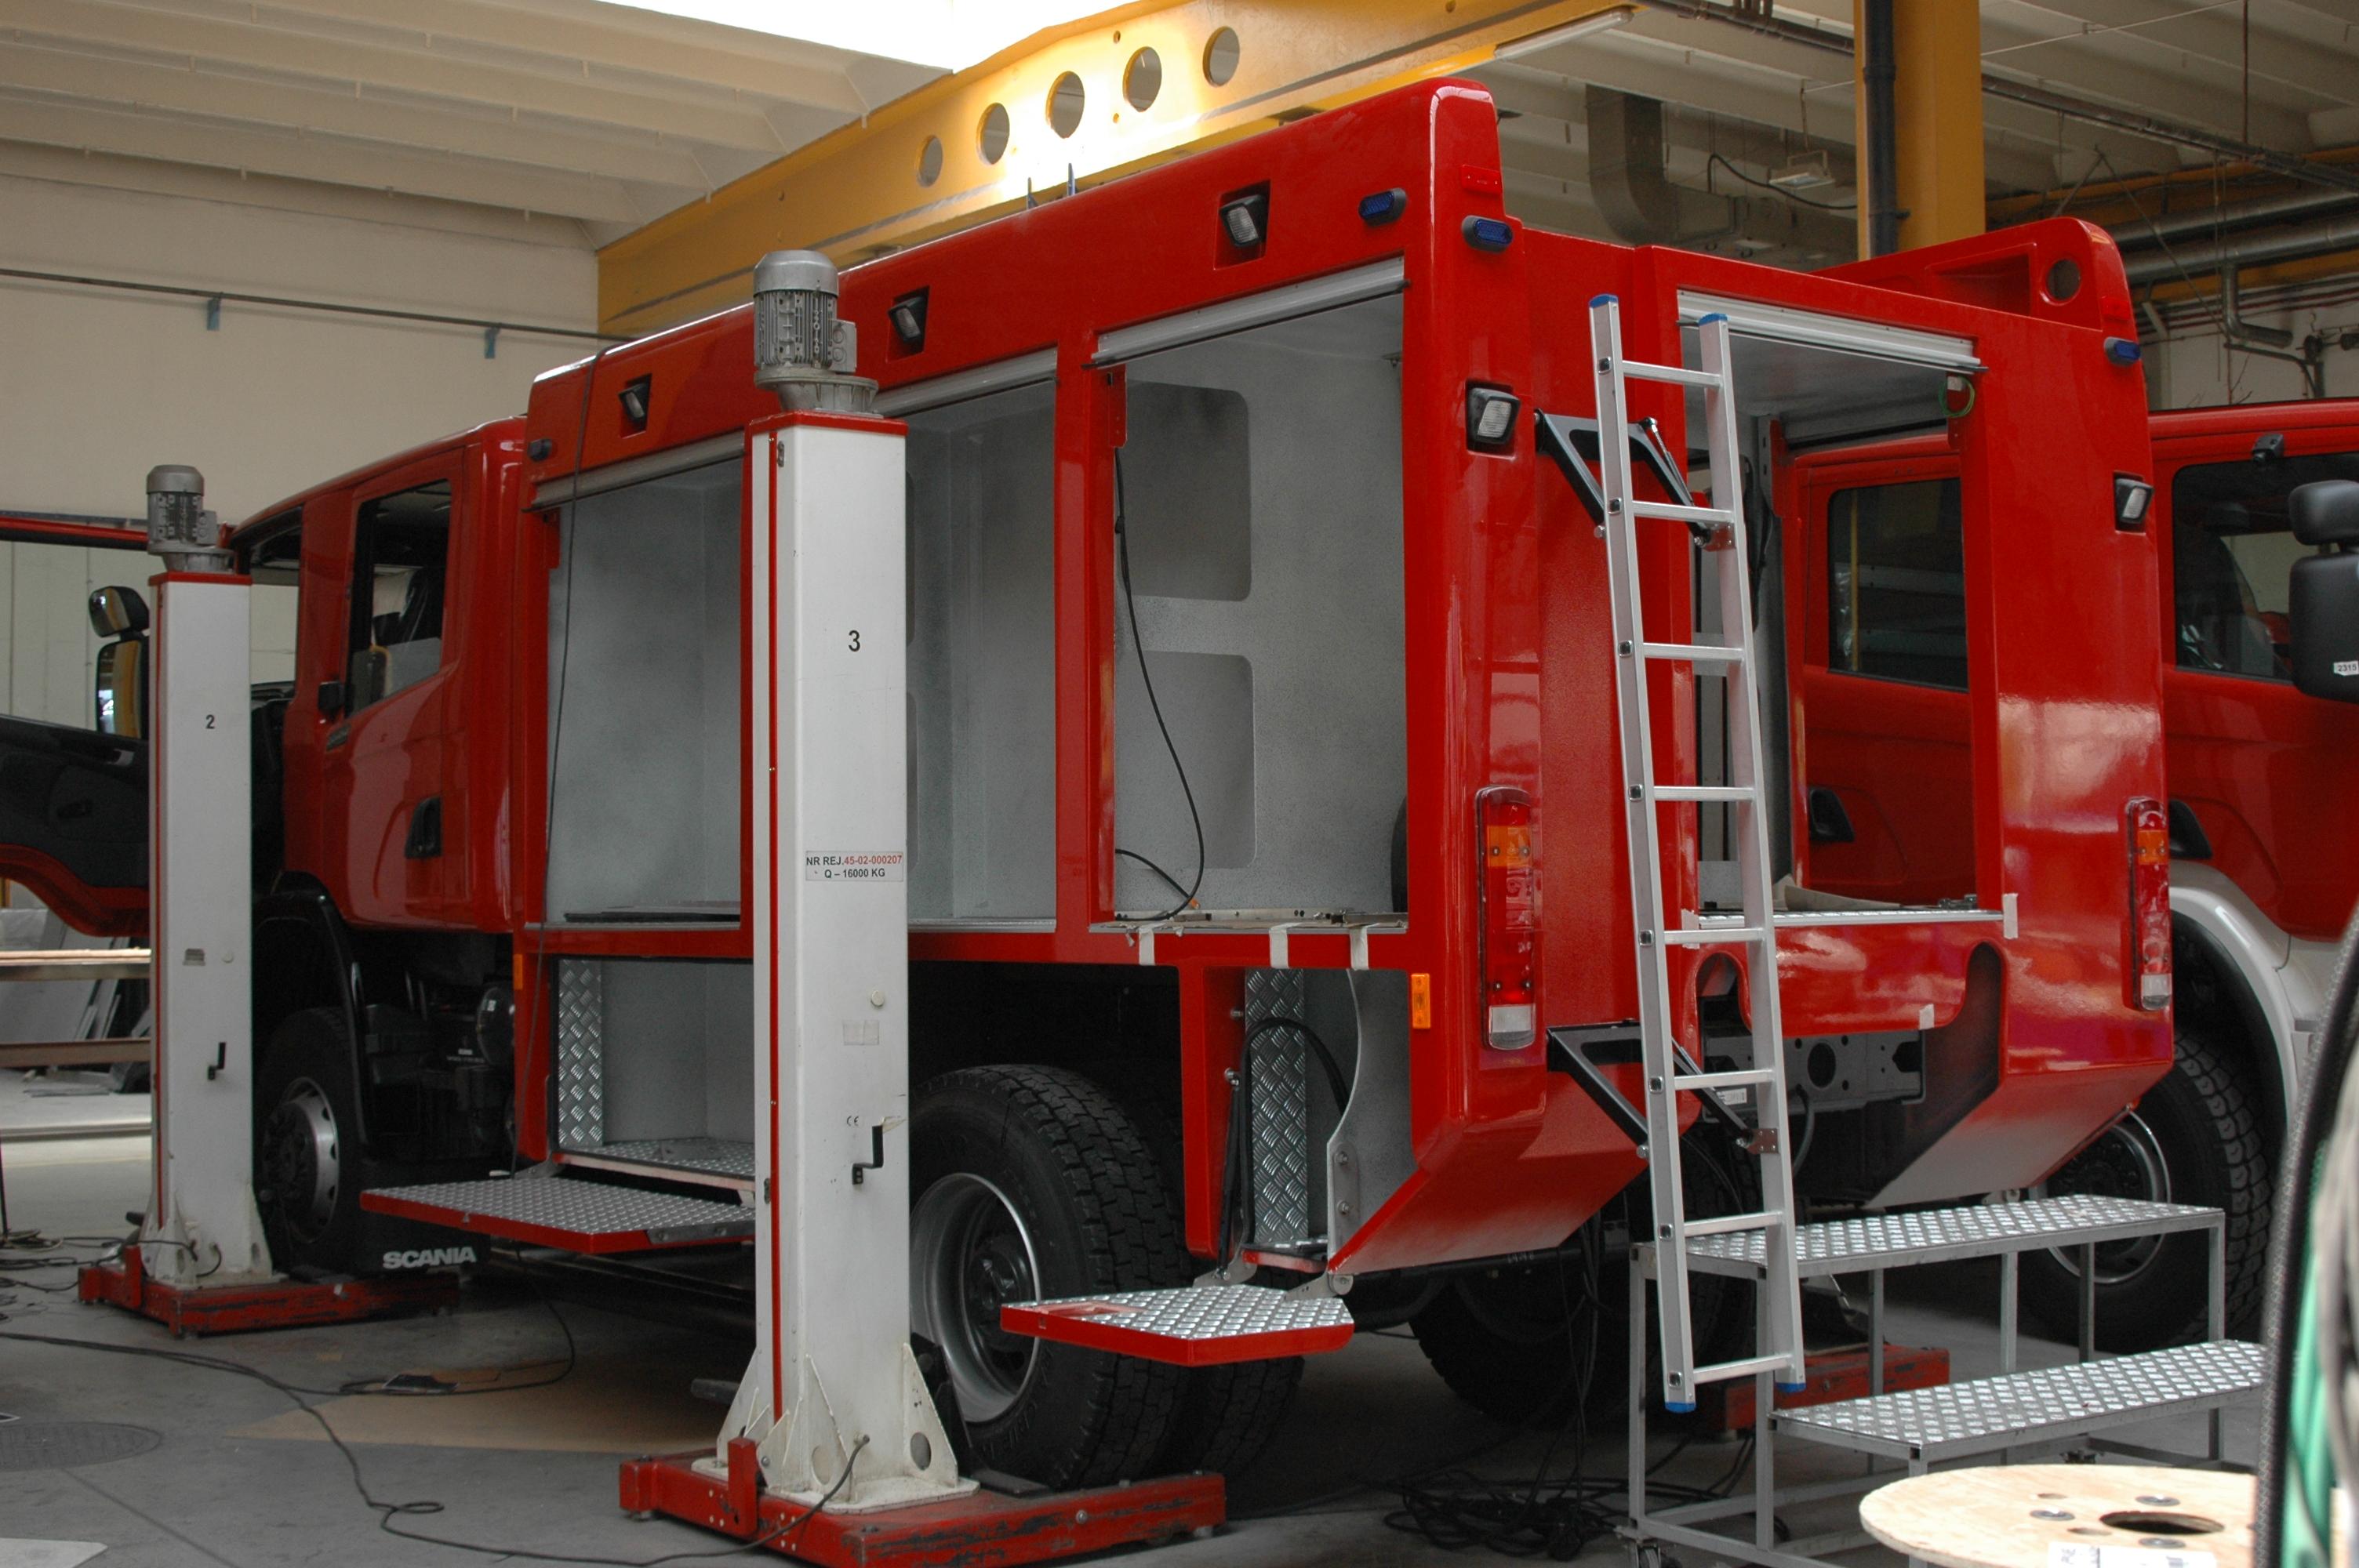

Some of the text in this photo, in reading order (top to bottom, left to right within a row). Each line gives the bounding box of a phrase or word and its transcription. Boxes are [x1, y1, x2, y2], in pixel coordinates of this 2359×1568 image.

[849, 630, 860, 652] 3
[205, 714, 215, 730] 2
[806, 856, 820, 866] NR
[824, 869, 832, 879] Q
[843, 869, 869, 878] 16000
[871, 868, 885, 877] KG
[383, 1247, 477, 1269] SCANIA
